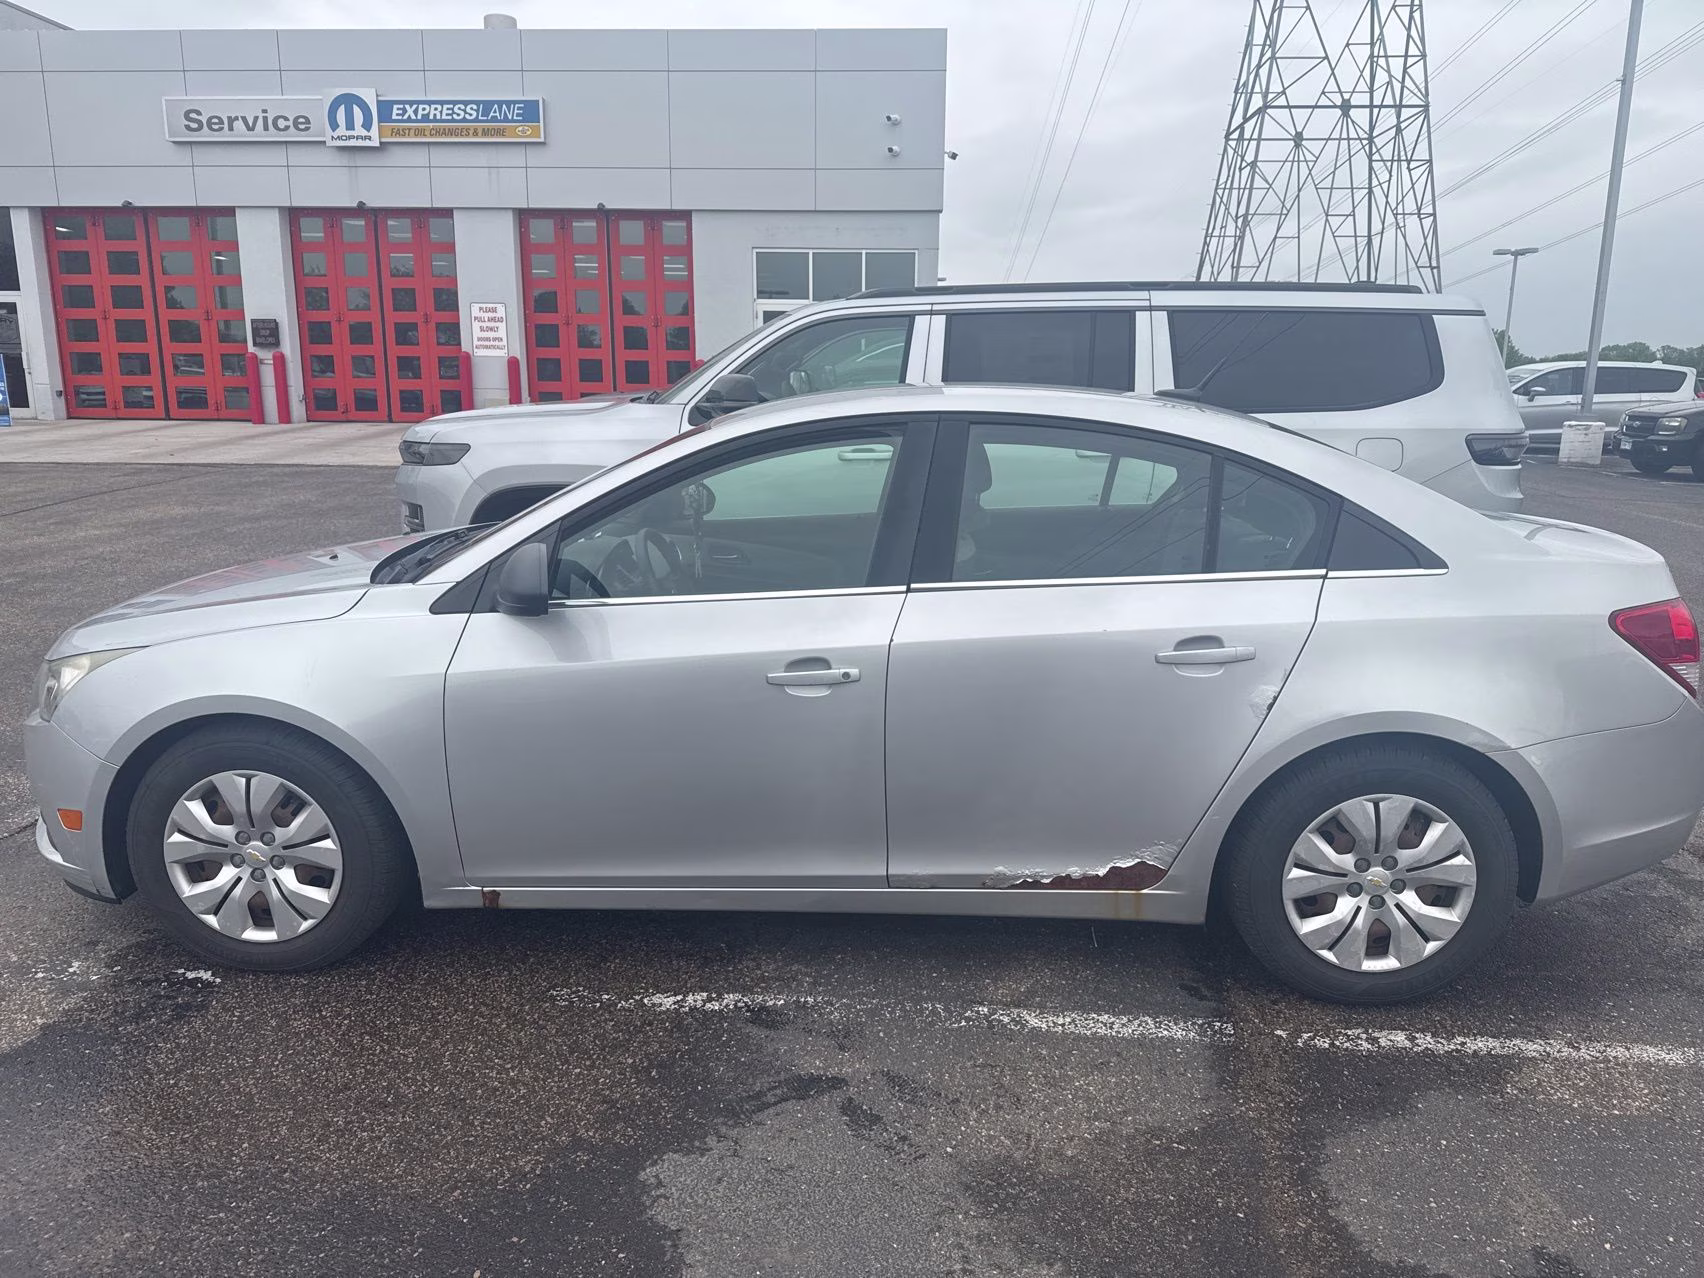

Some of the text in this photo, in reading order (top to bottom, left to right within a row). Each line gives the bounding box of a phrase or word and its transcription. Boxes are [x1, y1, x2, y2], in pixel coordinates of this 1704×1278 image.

[182, 108, 312, 133] Service
[390, 127, 413, 137] FAST
[414, 127, 428, 137] OIL
[429, 127, 471, 137] CHANGES
[472, 127, 479, 137] &
[481, 127, 507, 137] MORE
[331, 134, 373, 142] MOPAR
